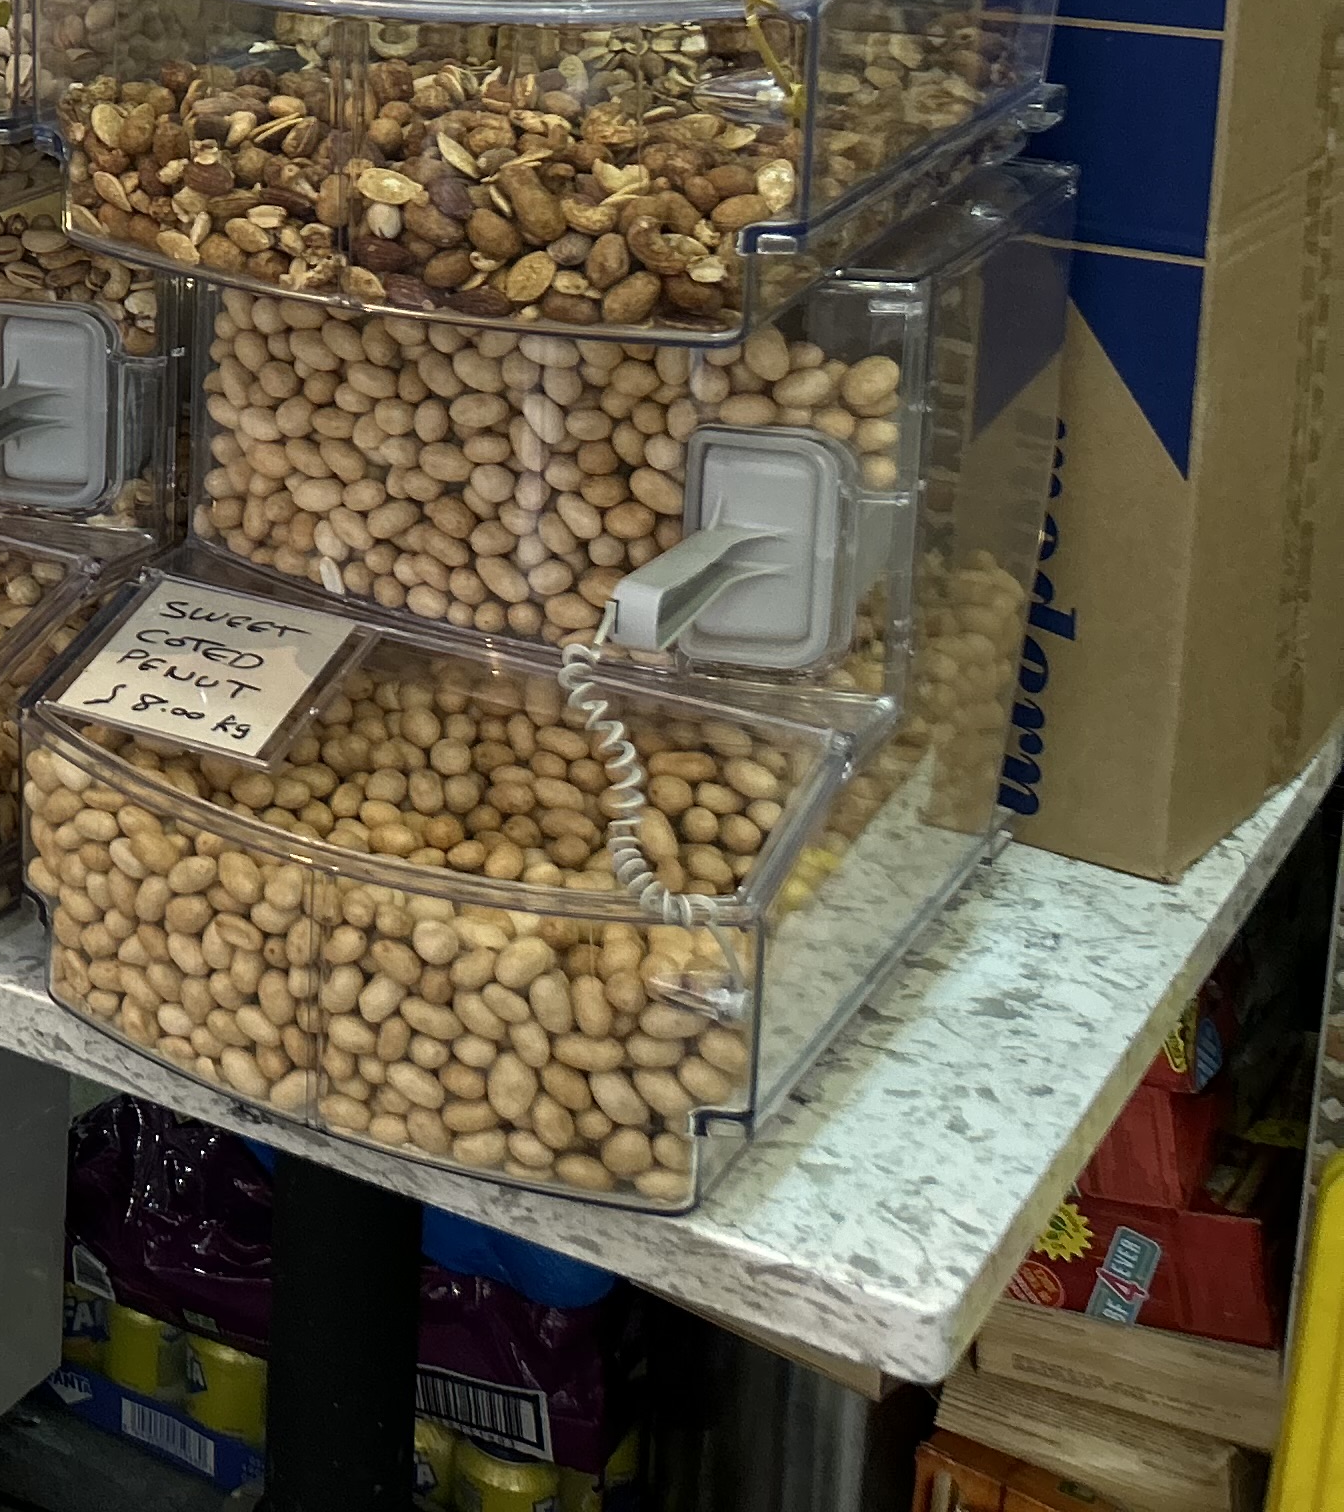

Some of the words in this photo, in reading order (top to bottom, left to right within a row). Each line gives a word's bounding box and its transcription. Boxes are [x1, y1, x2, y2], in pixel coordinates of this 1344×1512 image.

[159, 600, 312, 639] SWEET
[136, 628, 265, 670] COTED
[116, 648, 262, 700] PENUT
[1110, 1237, 1142, 1279] EVER
